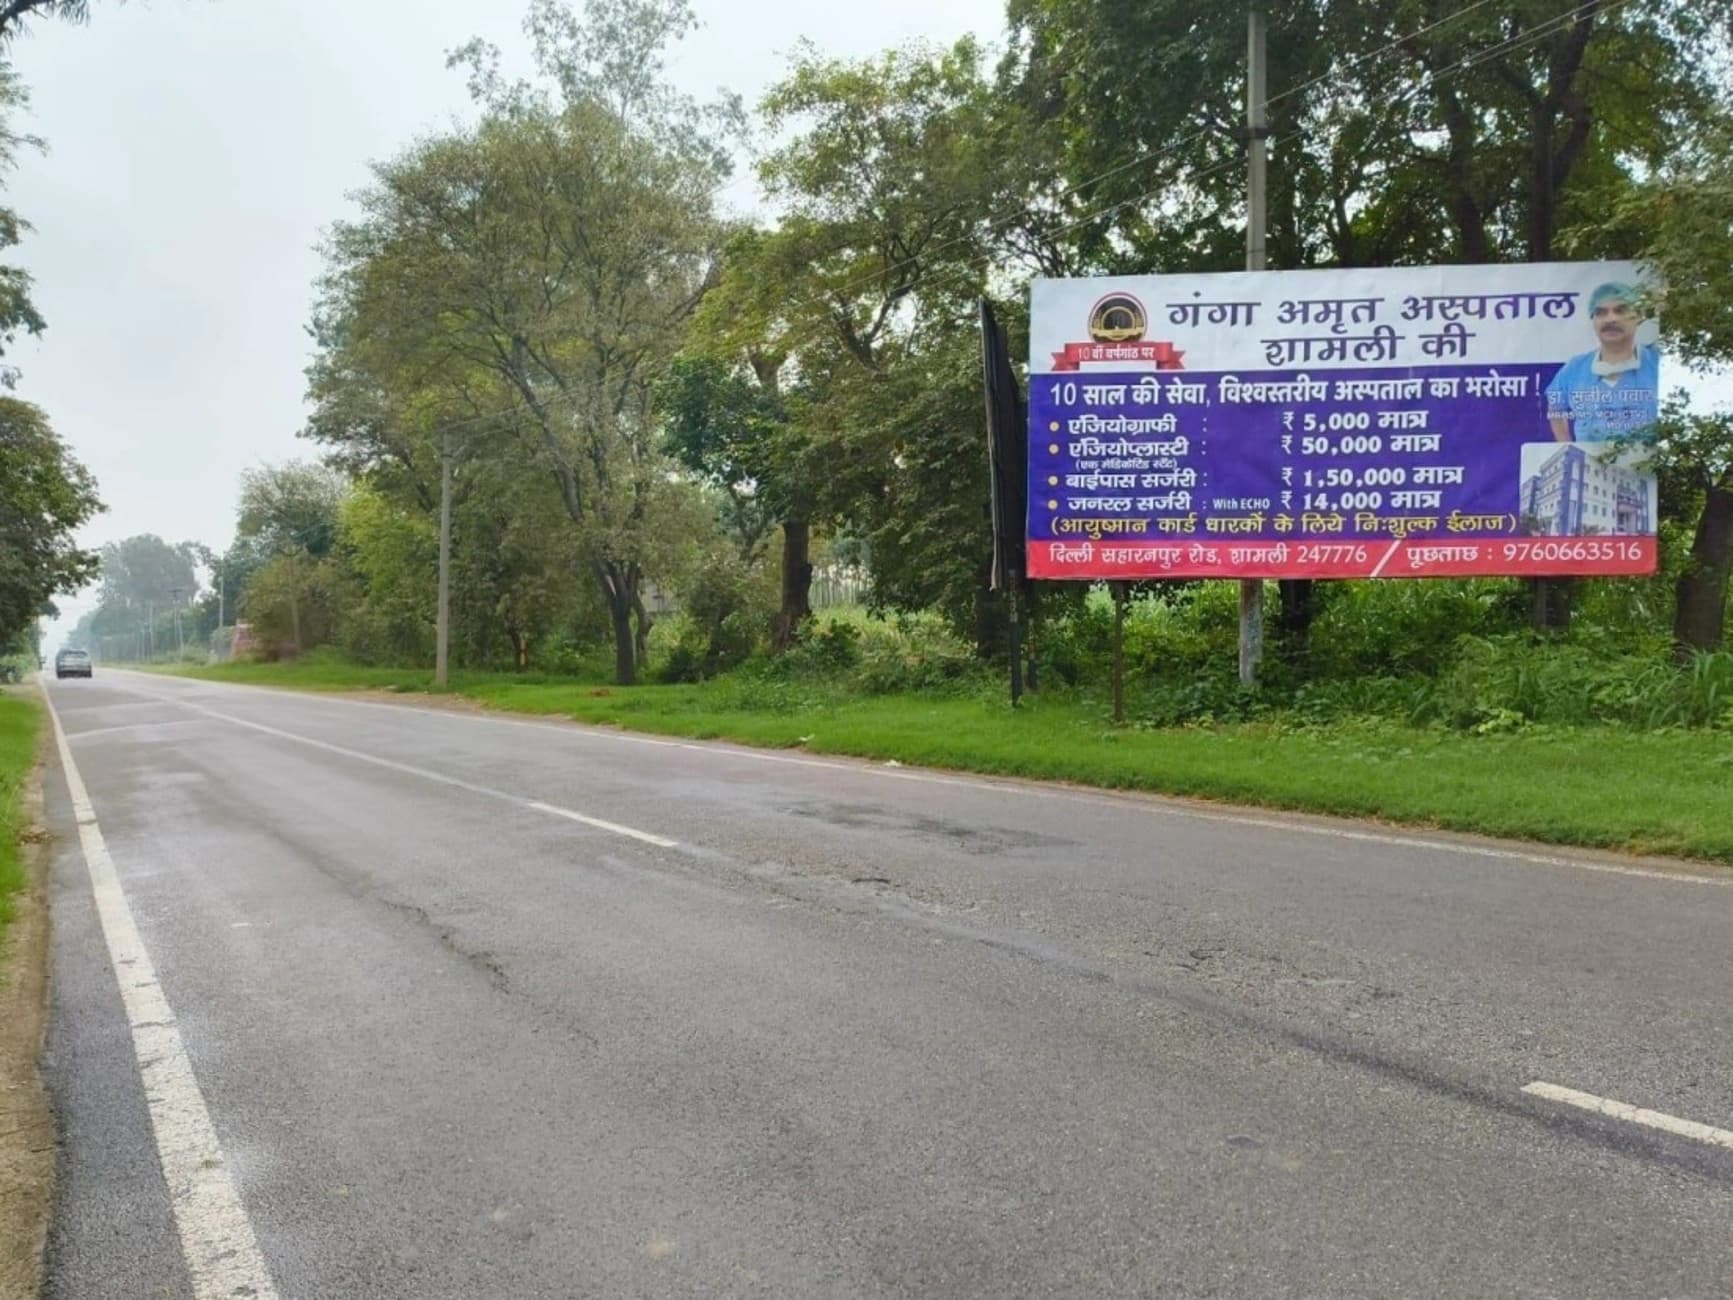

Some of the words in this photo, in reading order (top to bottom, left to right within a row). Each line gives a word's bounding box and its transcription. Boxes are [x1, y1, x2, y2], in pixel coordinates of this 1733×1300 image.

[1166, 291, 1261, 327] गंगा
[1277, 298, 1384, 334] अमृत
[1400, 292, 1580, 321] अस्पताल
[1141, 346, 1155, 359] पर
[1260, 324, 1405, 366] शामली
[1419, 322, 1476, 357] की
[1050, 382, 1077, 407] 10
[1083, 384, 1127, 406] साल
[1131, 377, 1160, 406] की
[1165, 379, 1212, 408] सेवा,
[1218, 374, 1329, 404] विश्वस्तरीय
[1334, 378, 1424, 402] अस्पताल
[1430, 378, 1459, 399] का
[1465, 370, 1528, 398] भरोसा
[1303, 412, 1370, 432] 5,000
[1377, 410, 1429, 429] मात्र
[1301, 436, 1382, 456] 50,000
[1390, 434, 1442, 452] मात्र
[1065, 470, 1136, 490] बाईपास
[1141, 469, 1197, 489] सर्जरी
[1303, 468, 1406, 488] 1,50,000
[1413, 466, 1465, 484] मात्र
[1067, 496, 1133, 511] जनरल
[1136, 492, 1192, 511] सर्जरी
[1212, 498, 1238, 510] With
[1240, 498, 1271, 510] ECHO
[1303, 491, 1382, 511] 14,000
[1390, 490, 1442, 509] मात्र
[1157, 512, 1198, 533] कार्ड
[1273, 510, 1295, 532] के
[1301, 511, 1346, 533] लिये
[1049, 542, 1096, 563] दिल्ली
[1101, 548, 1182, 569] सहारनपुर
[1229, 542, 1291, 564] शामली
[1296, 544, 1367, 563] 247776
[1406, 546, 1480, 568] पूछताछ
[1503, 541, 1642, 562] 9760663516
